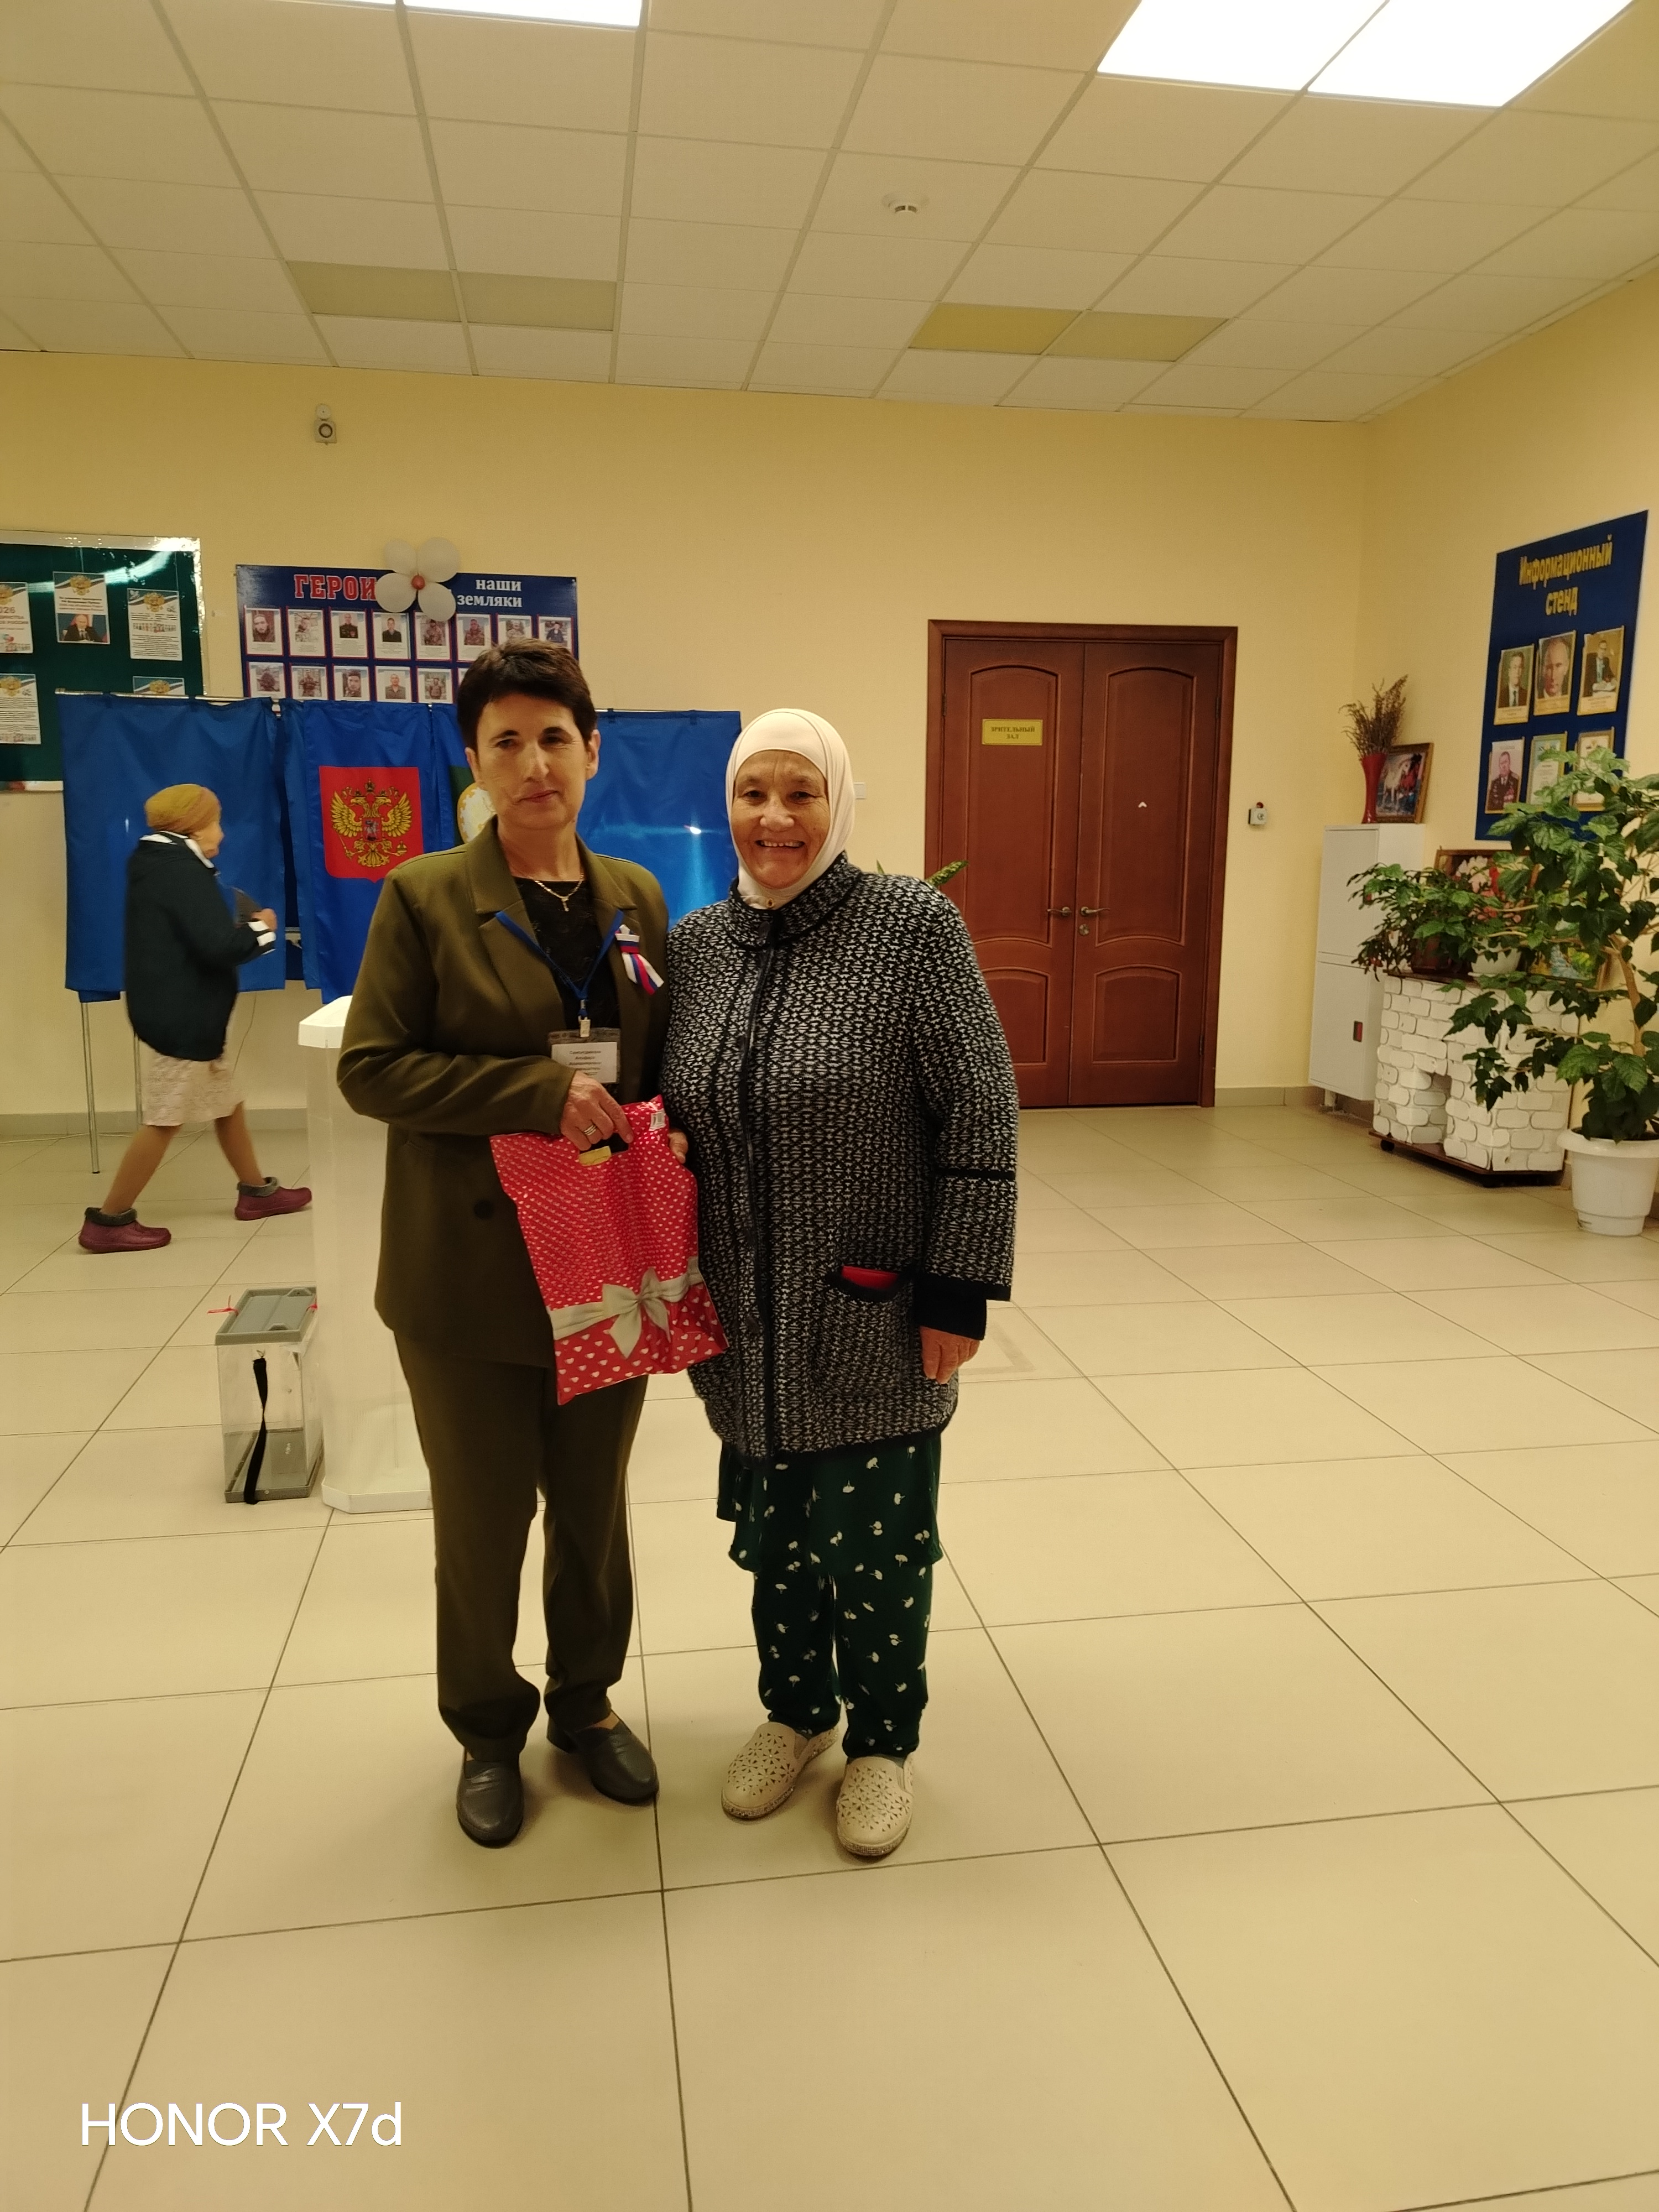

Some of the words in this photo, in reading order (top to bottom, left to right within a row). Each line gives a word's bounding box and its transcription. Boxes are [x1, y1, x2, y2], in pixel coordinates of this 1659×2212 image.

[1519, 534, 1613, 590] Информационный
[294, 574, 377, 601] ГЕРОИ
[475, 579, 522, 591] наши
[457, 594, 523, 608] земляки
[1546, 586, 1578, 617] стенд
